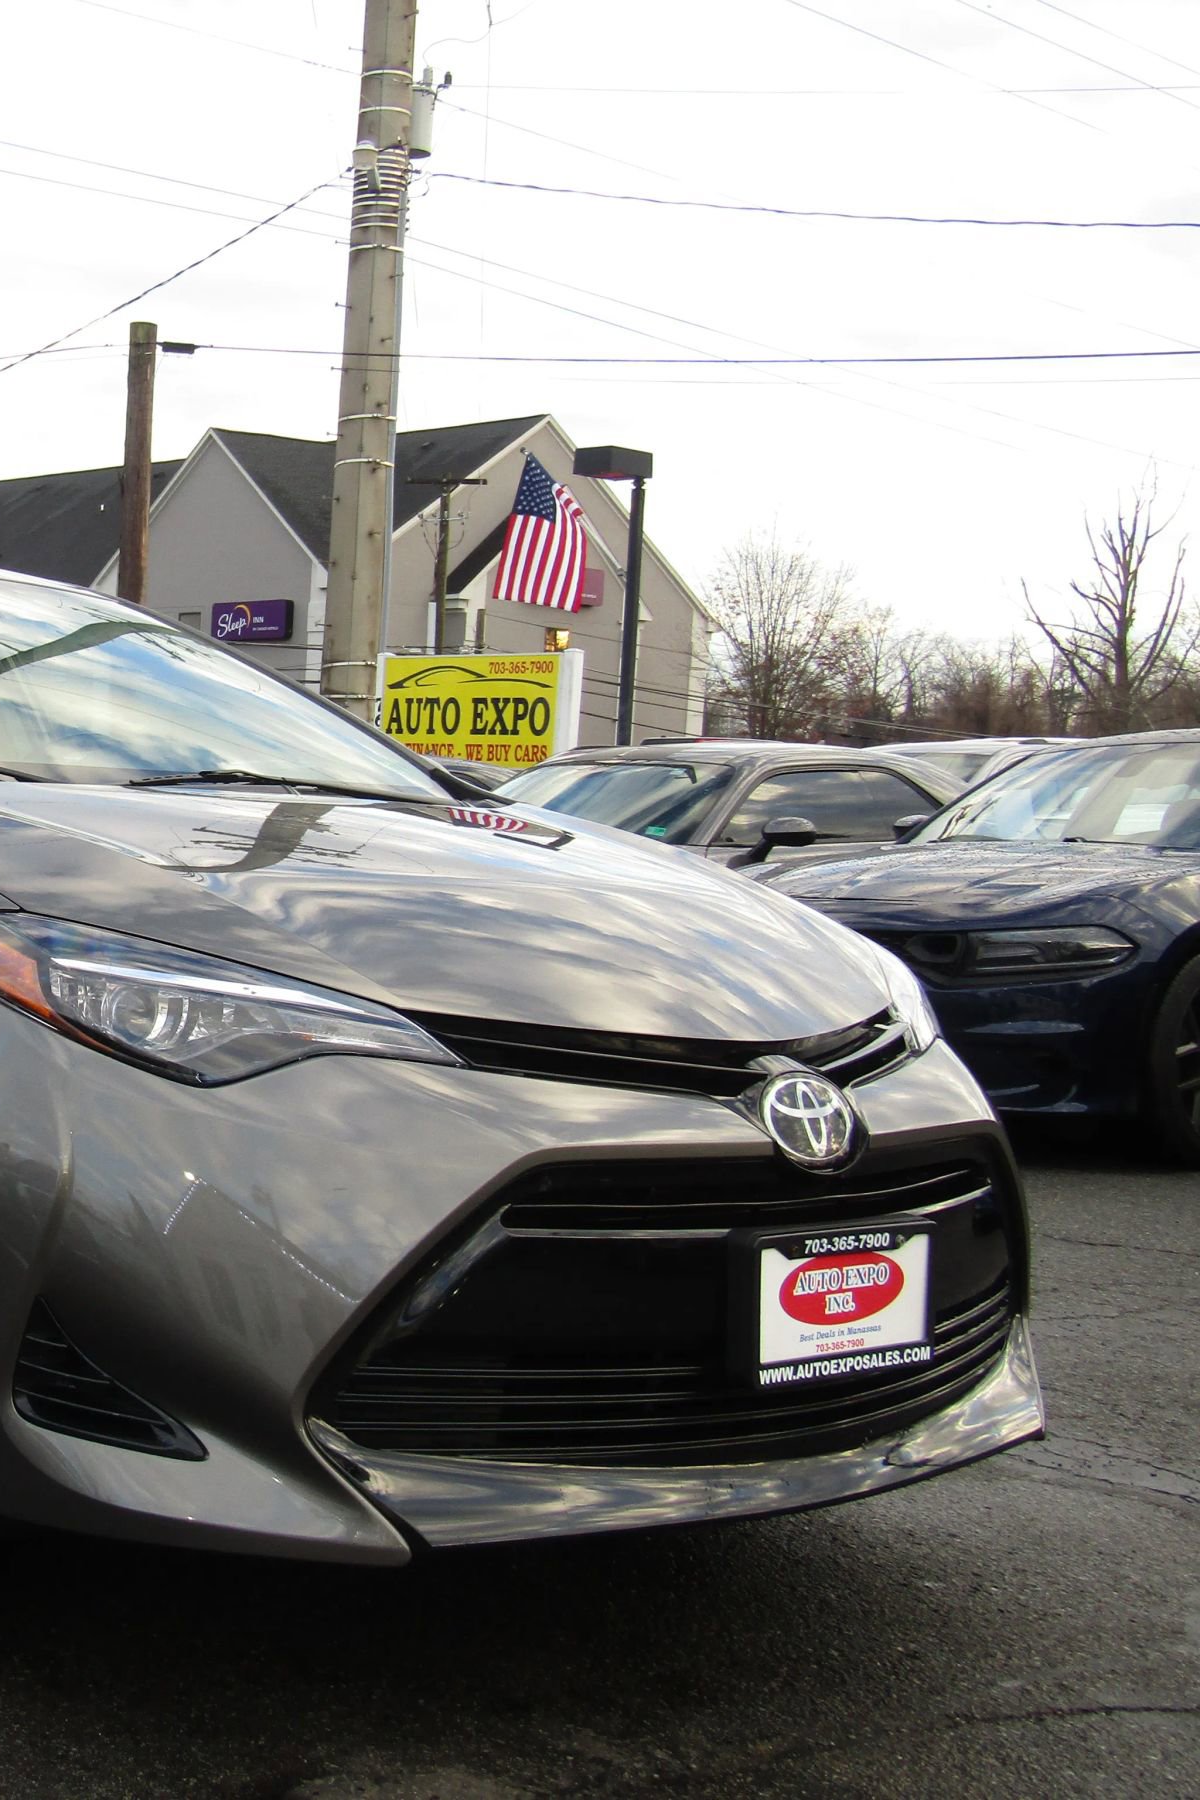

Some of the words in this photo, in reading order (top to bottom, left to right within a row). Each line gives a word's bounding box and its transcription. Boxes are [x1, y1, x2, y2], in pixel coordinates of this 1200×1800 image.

[217, 613, 246, 637] Sleep
[488, 661, 554, 675] 703-365-7900
[385, 697, 461, 735] AUTO
[469, 697, 551, 736] EXPO
[404, 742, 454, 758] INANCE
[465, 744, 482, 761] WE
[486, 744, 511, 762] BUY
[514, 745, 548, 762] CARS
[804, 1233, 890, 1254] 703-365-7900
[794, 1268, 841, 1295] AUTO
[843, 1262, 889, 1288] EXPO
[825, 1292, 855, 1314] INC.
[800, 1334, 814, 1342] Best
[816, 1330, 836, 1340] Deals
[847, 1325, 881, 1335] Manassas
[816, 1338, 865, 1352] 703-365-7900
[759, 1346, 931, 1385] WWW.AUTOEXPOSALES.COM
